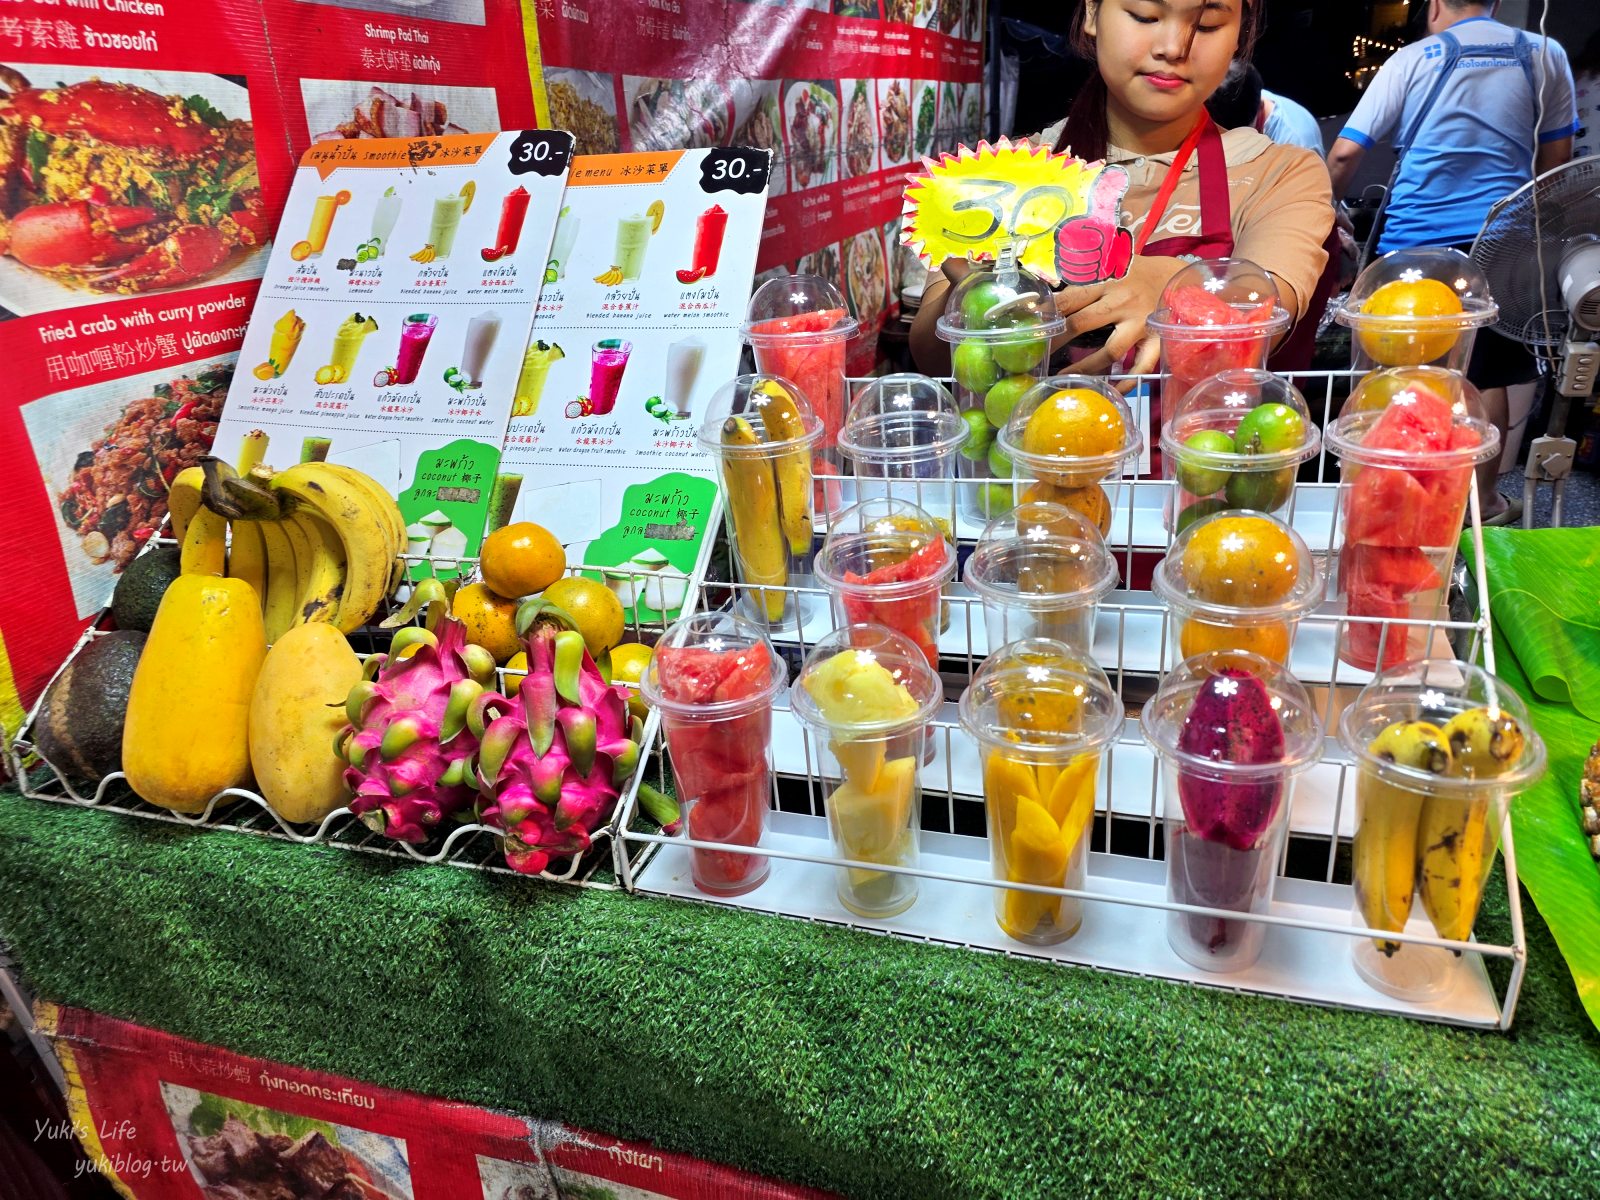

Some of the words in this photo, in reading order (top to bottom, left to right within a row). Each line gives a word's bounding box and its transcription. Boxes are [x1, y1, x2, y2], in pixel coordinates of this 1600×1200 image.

[365, 24, 396, 44] Shrimp
[398, 28, 412, 42] Pad
[413, 29, 429, 44] Thai
[519, 141, 564, 162] 30.-
[585, 167, 613, 178] menu
[711, 157, 762, 181] 30.-
[942, 178, 1076, 246] 30
[38, 321, 77, 346] Fried
[81, 313, 118, 337] crab
[120, 309, 155, 329] with
[158, 306, 194, 323] curry
[199, 294, 247, 319] powder
[435, 454, 475, 470] มะพร้าว
[421, 472, 458, 482] coconut
[645, 488, 689, 506] มะพร้าว
[629, 508, 671, 518] coconut
[260, 1070, 376, 1110] กุ้งทอดกระเทียม
